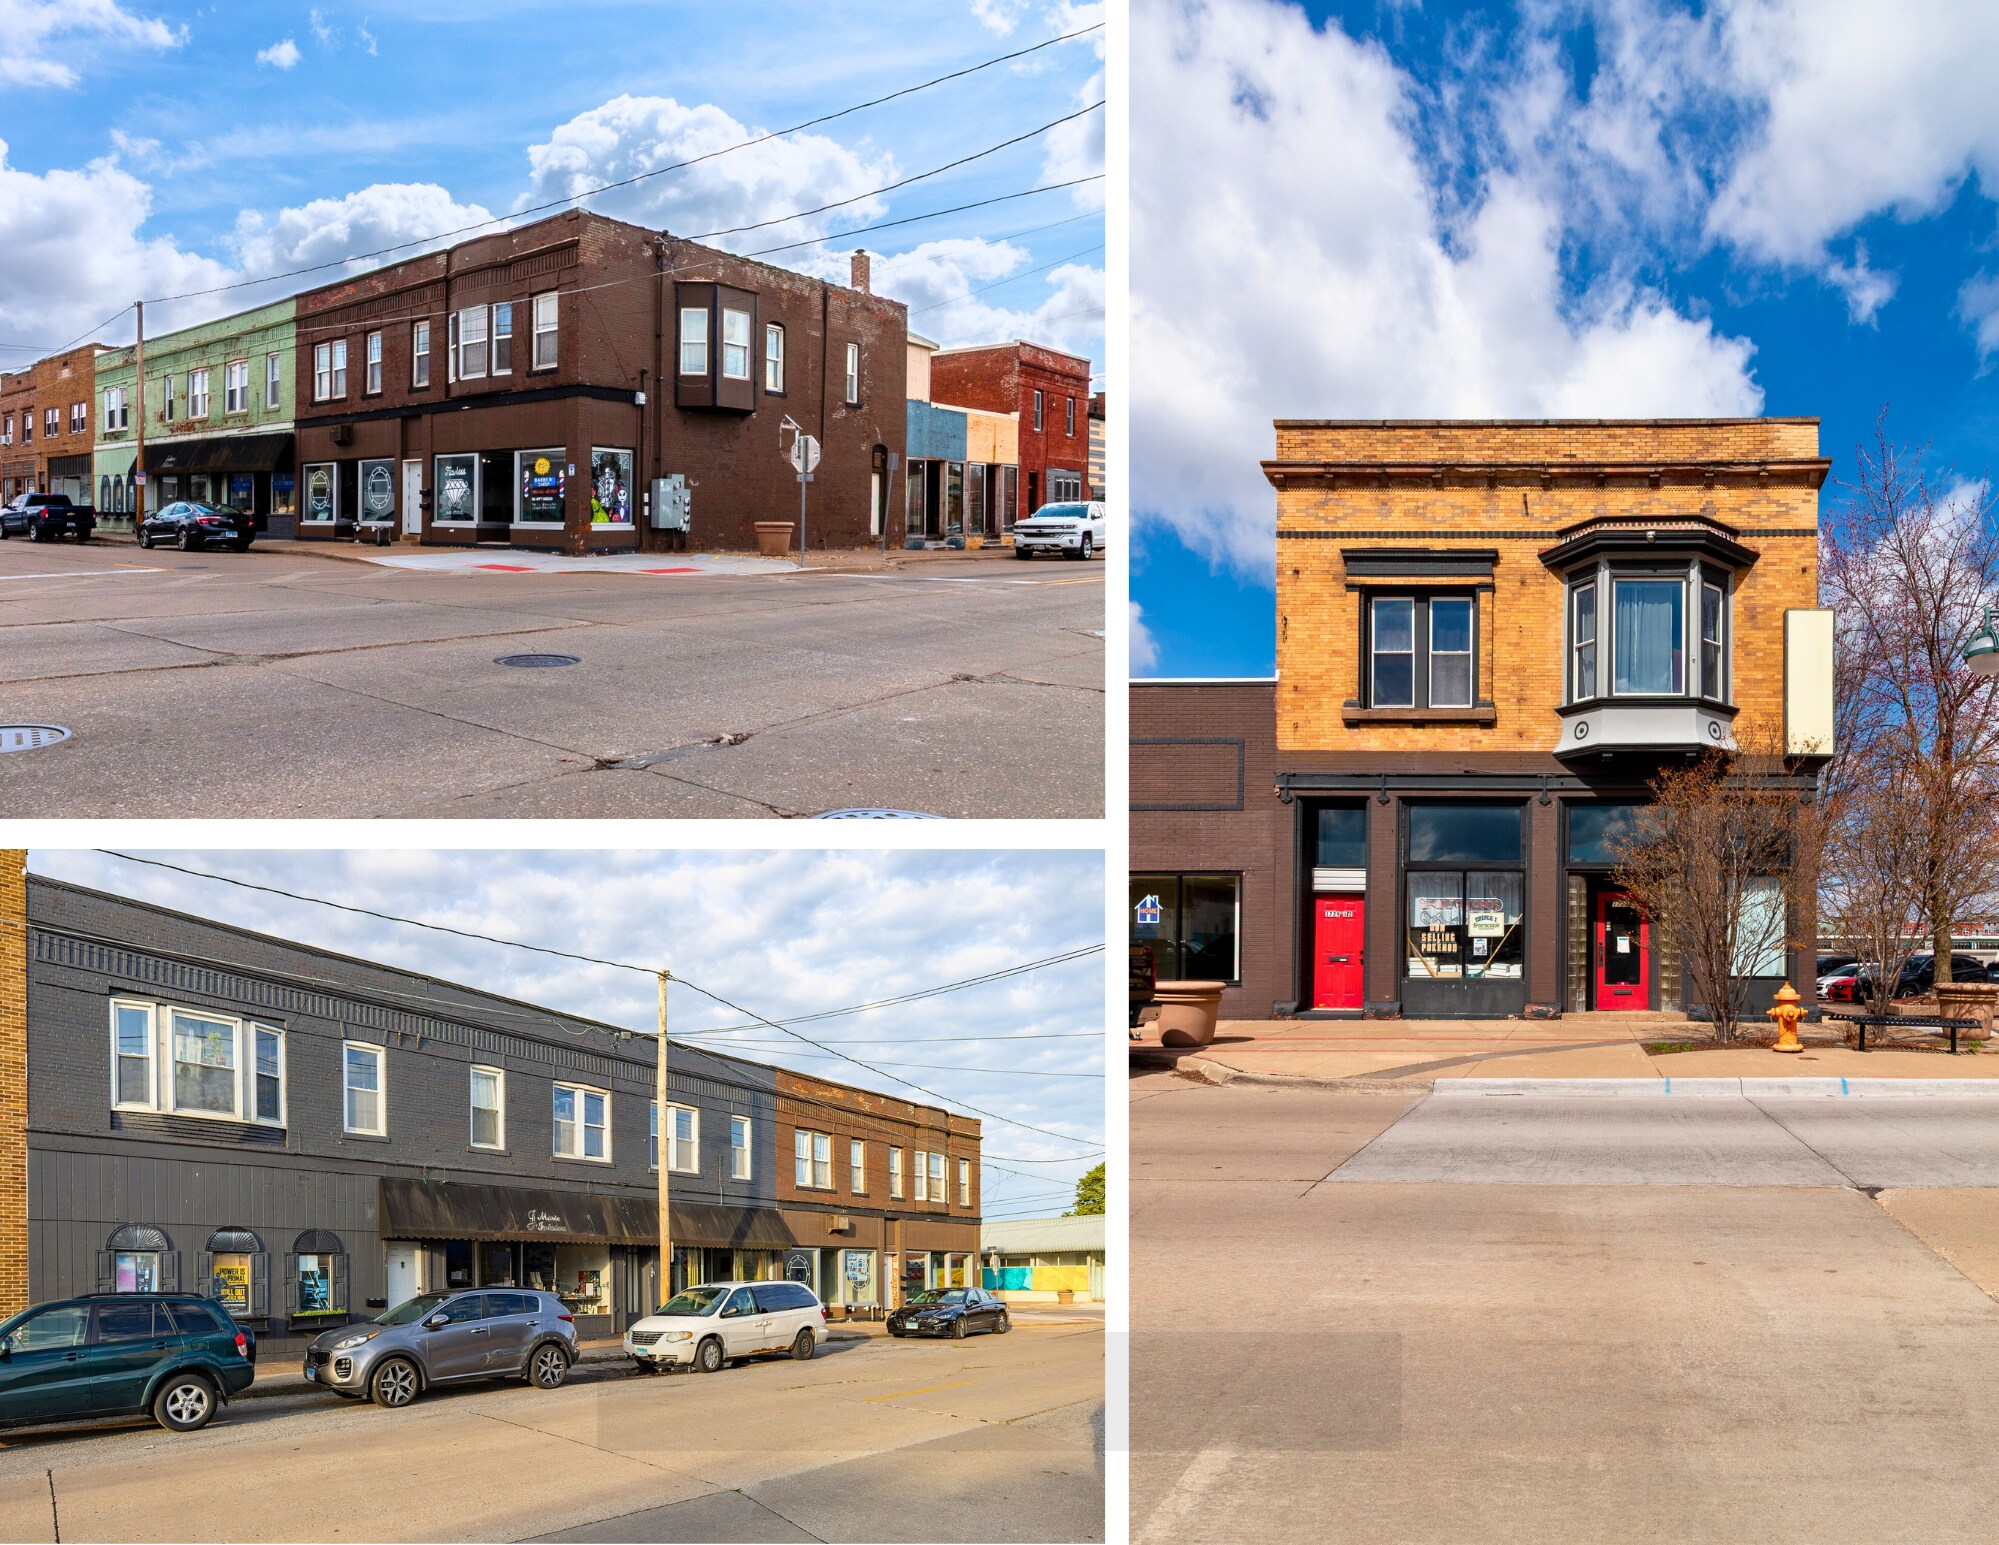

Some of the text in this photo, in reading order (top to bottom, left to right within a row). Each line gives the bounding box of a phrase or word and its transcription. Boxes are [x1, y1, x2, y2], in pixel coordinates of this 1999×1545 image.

[1419, 899, 1462, 910] SPORTS
[1429, 924, 1446, 932] NOW
[1421, 932, 1456, 942] SELLING
[220, 1267, 246, 1275] POWER IS
